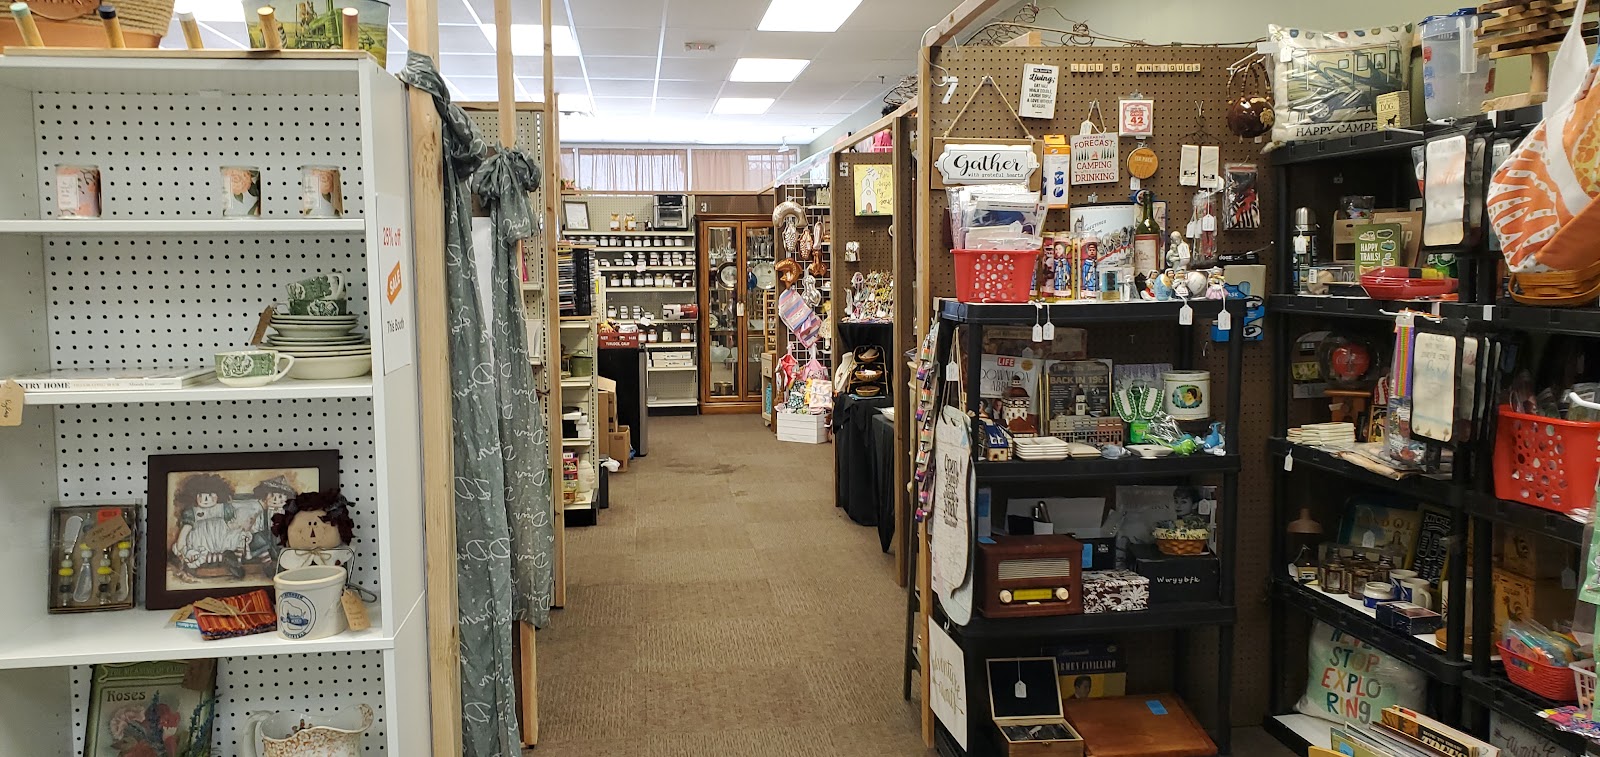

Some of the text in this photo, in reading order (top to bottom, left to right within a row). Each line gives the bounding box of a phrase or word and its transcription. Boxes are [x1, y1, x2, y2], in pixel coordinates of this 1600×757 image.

[1138, 64, 1199, 72] ANTIQUES
[1296, 122, 1378, 137] HAPPY CAMPE
[1074, 140, 1116, 149] FORECAST:
[954, 153, 1023, 177] Gather
[1076, 160, 1112, 170] CAMPING
[1075, 172, 1115, 182] DRINKING
[701, 202, 707, 212] 3
[383, 227, 393, 246] 25%
[1360, 243, 1378, 252] HAPPY
[1360, 252, 1381, 261] TRAILS!
[389, 269, 401, 296] SALE
[387, 319, 405, 333] This Booth
[998, 359, 1014, 367] LIFE
[1075, 376, 1086, 384] IN
[44, 381, 70, 390] HOME
[1157, 576, 1200, 585] Wwyybfk
[1329, 647, 1380, 672] STOP
[1321, 668, 1382, 699] EXPLO
[107, 690, 146, 702] Roses
